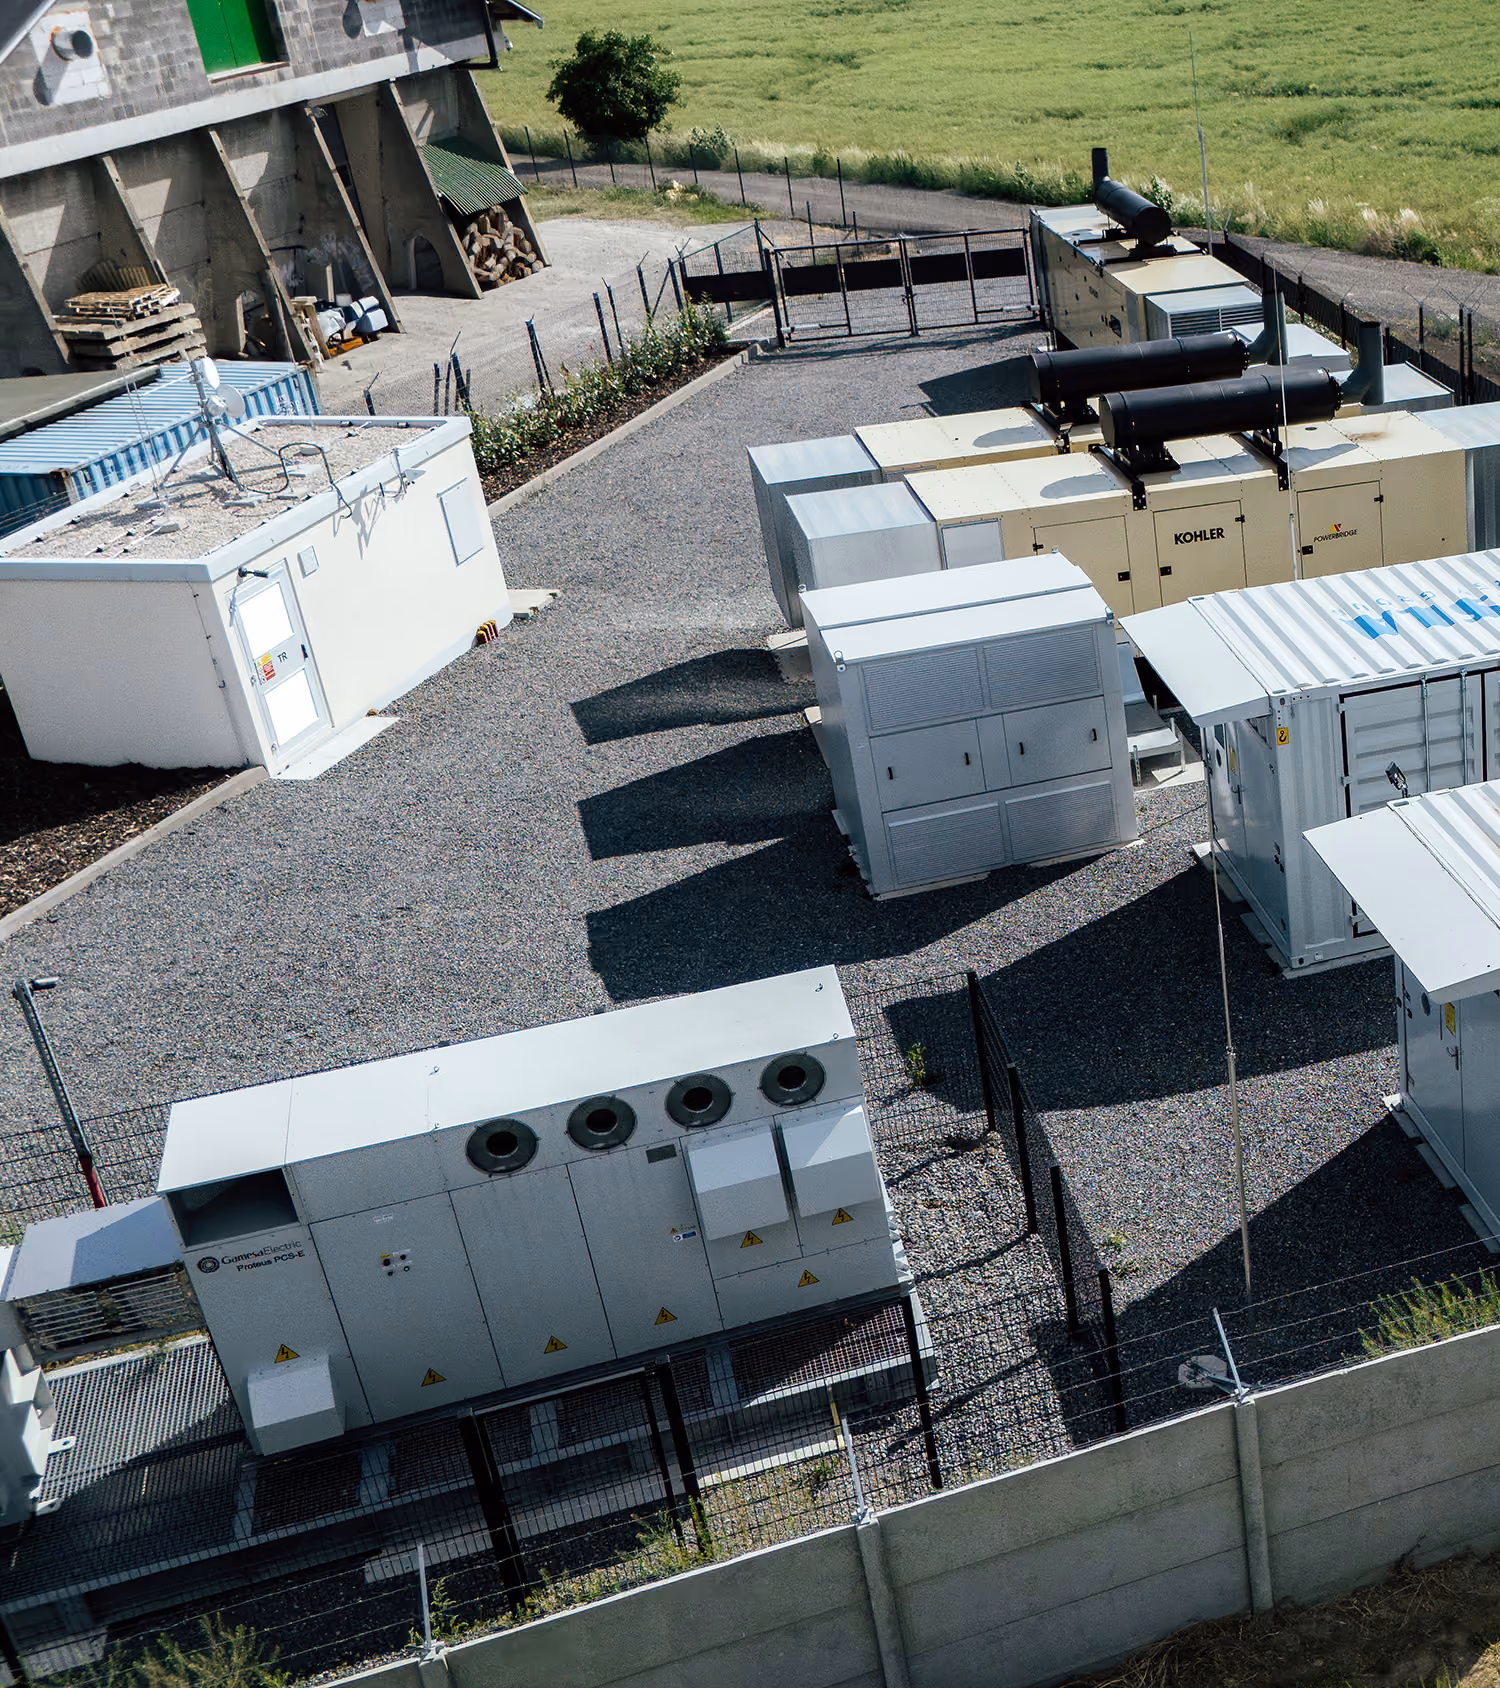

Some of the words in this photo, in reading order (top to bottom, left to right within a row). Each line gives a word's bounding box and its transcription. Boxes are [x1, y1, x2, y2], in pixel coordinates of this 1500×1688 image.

[1174, 527, 1225, 545] KOHLER
[1313, 528, 1358, 543] POWERBRIDGE
[277, 651, 288, 663] TR
[236, 1258, 273, 1272] Proteus
[273, 1249, 305, 1264] PCS-E
